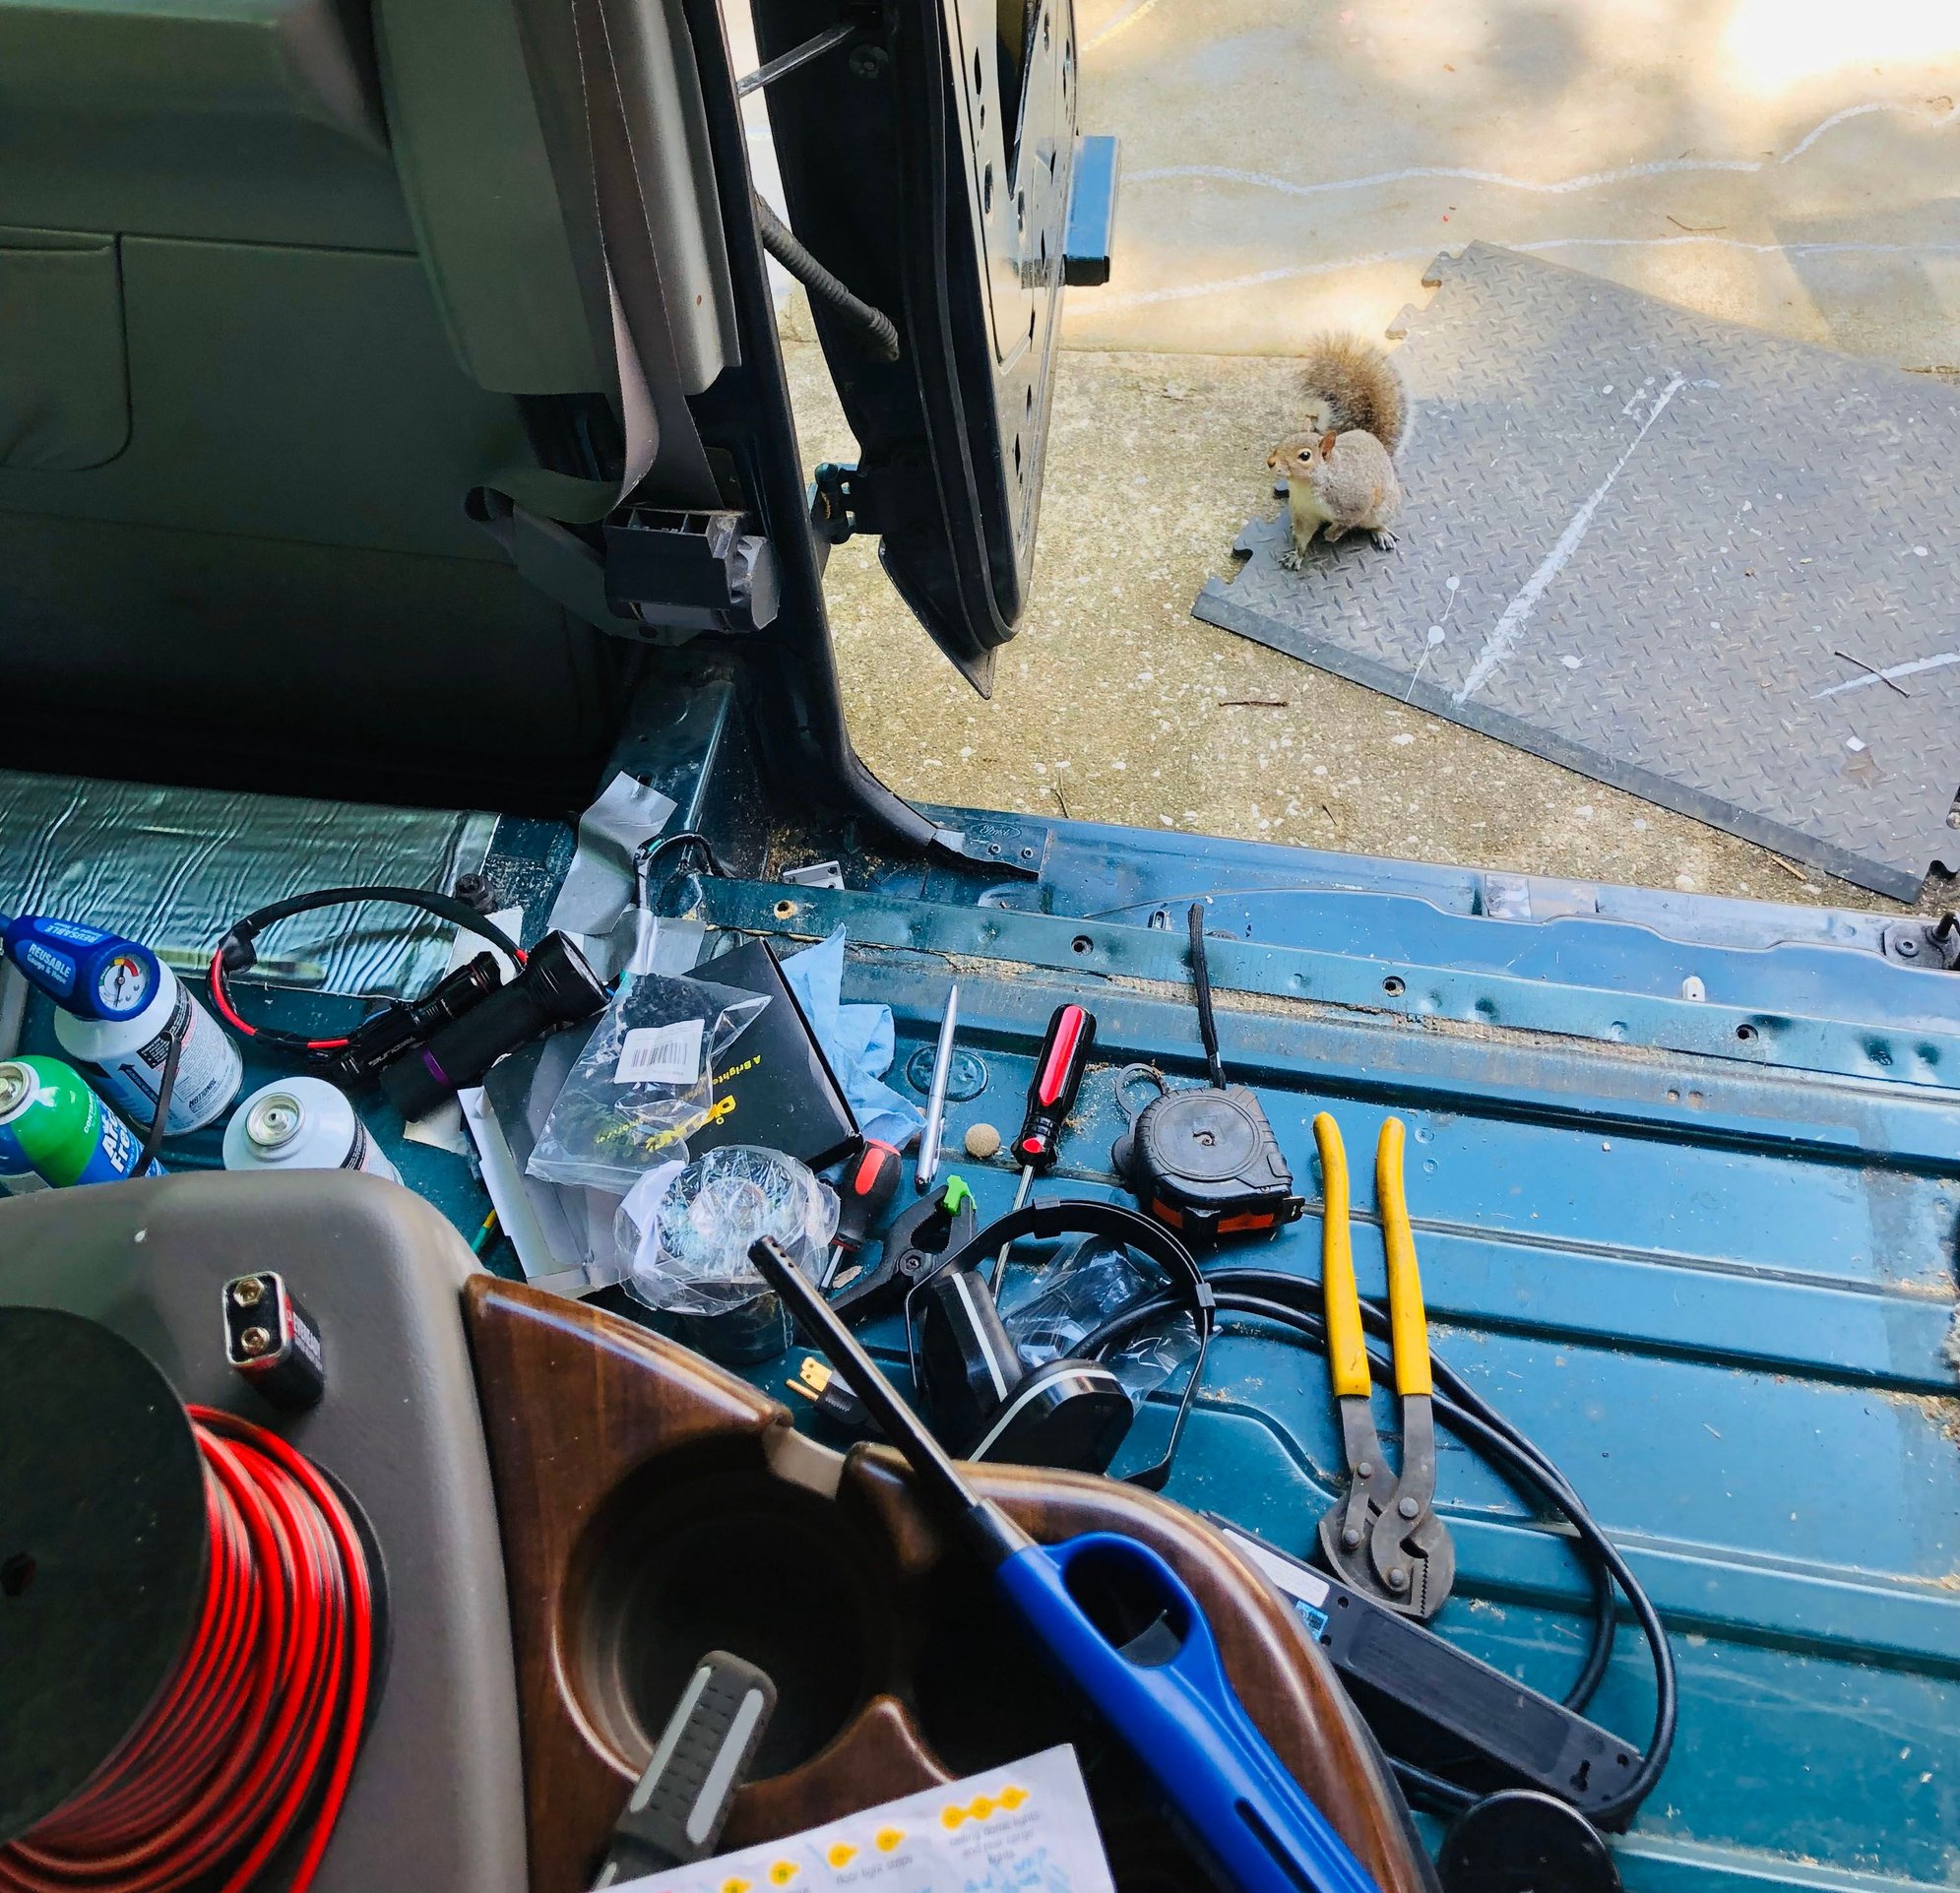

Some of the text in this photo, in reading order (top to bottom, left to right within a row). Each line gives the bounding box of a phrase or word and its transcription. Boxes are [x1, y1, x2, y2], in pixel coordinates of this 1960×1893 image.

[44, 924, 98, 943] REUSABLE
[28, 953, 45, 971] Gauge
[51, 970, 67, 984] Hose
[29, 943, 71, 978] REUSABLE
[710, 1054, 762, 1086] A Brighte
[963, 1845, 981, 1860] and
